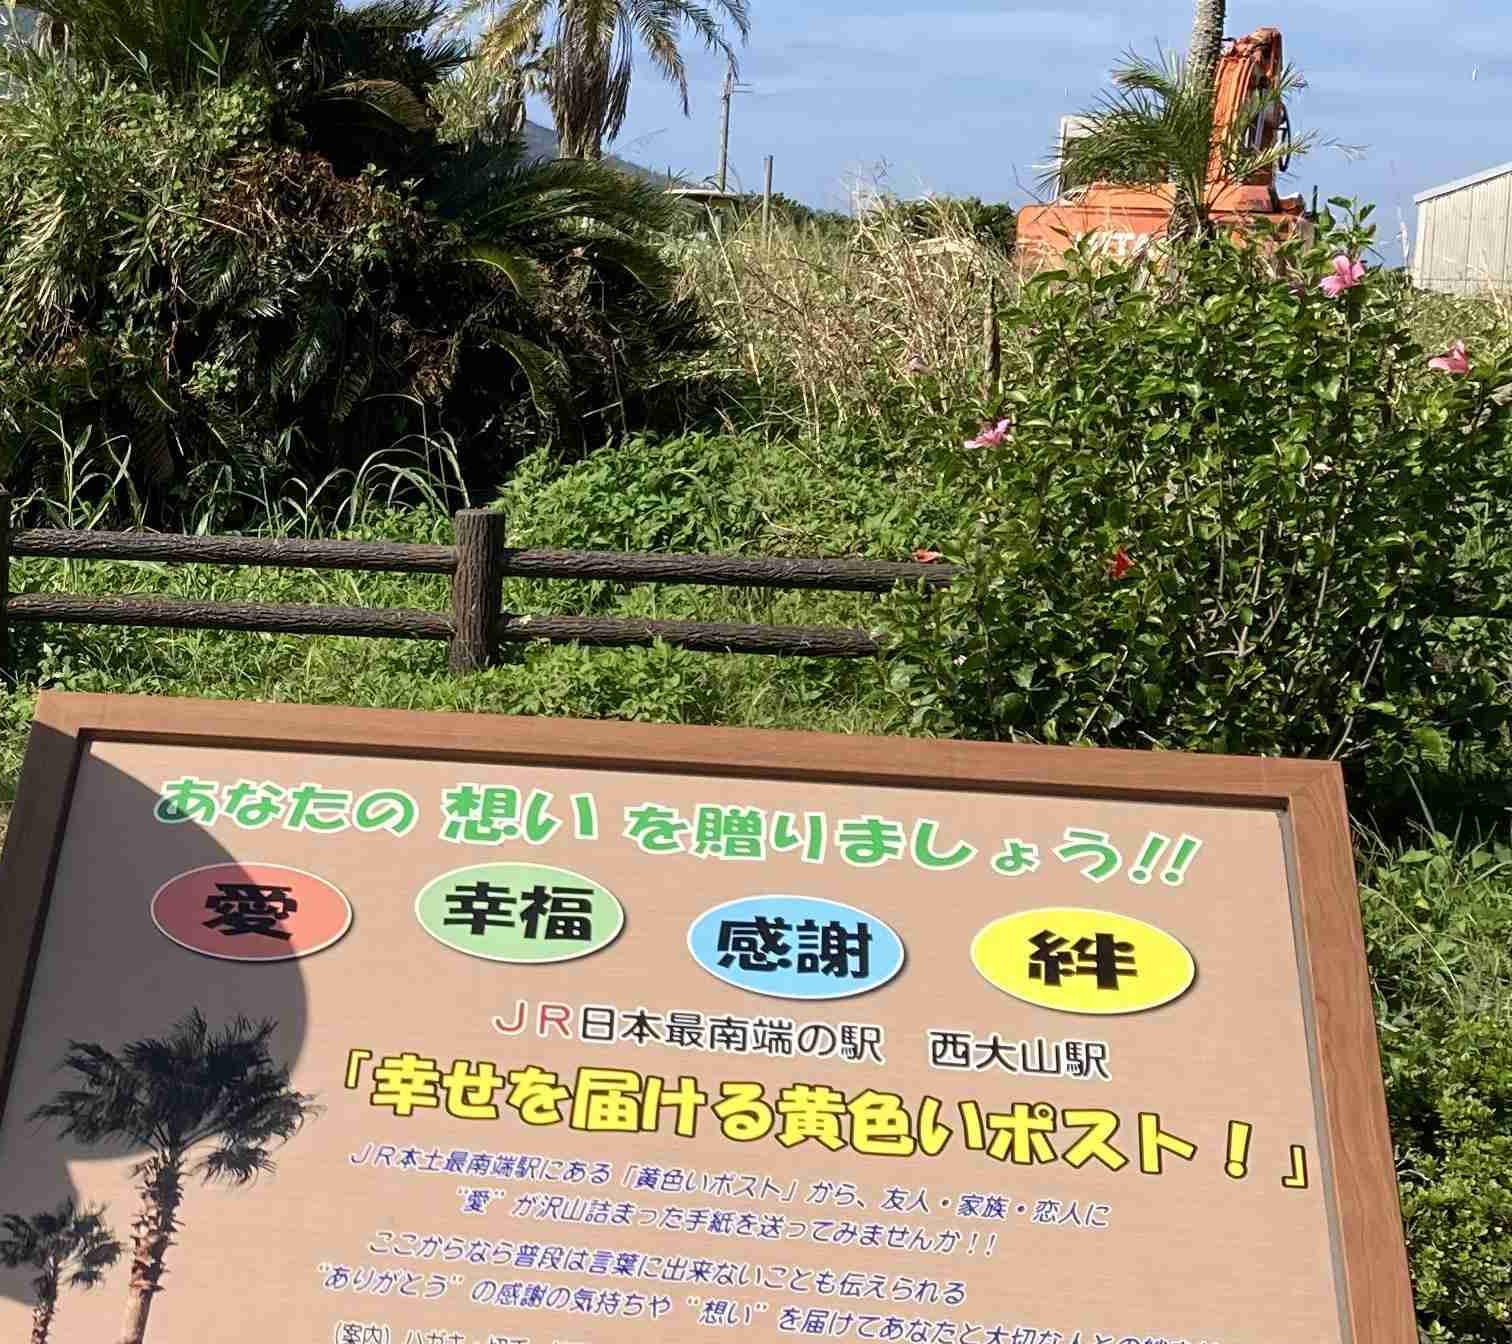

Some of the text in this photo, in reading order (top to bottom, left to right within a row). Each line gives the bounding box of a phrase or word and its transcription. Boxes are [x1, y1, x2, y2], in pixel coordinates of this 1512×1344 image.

[155, 777, 418, 840] あなたの
[439, 784, 599, 846] 想い
[202, 880, 298, 942] 愛
[442, 880, 595, 943] 幸福
[716, 915, 874, 980] 感謝
[1027, 929, 1139, 991] 絆
[493, 1000, 1111, 1080] JR日本最南端の駅 西大山駅
[369, 1231, 967, 1305] ここからなら普段は言葉に出来ないことも伝えられる
